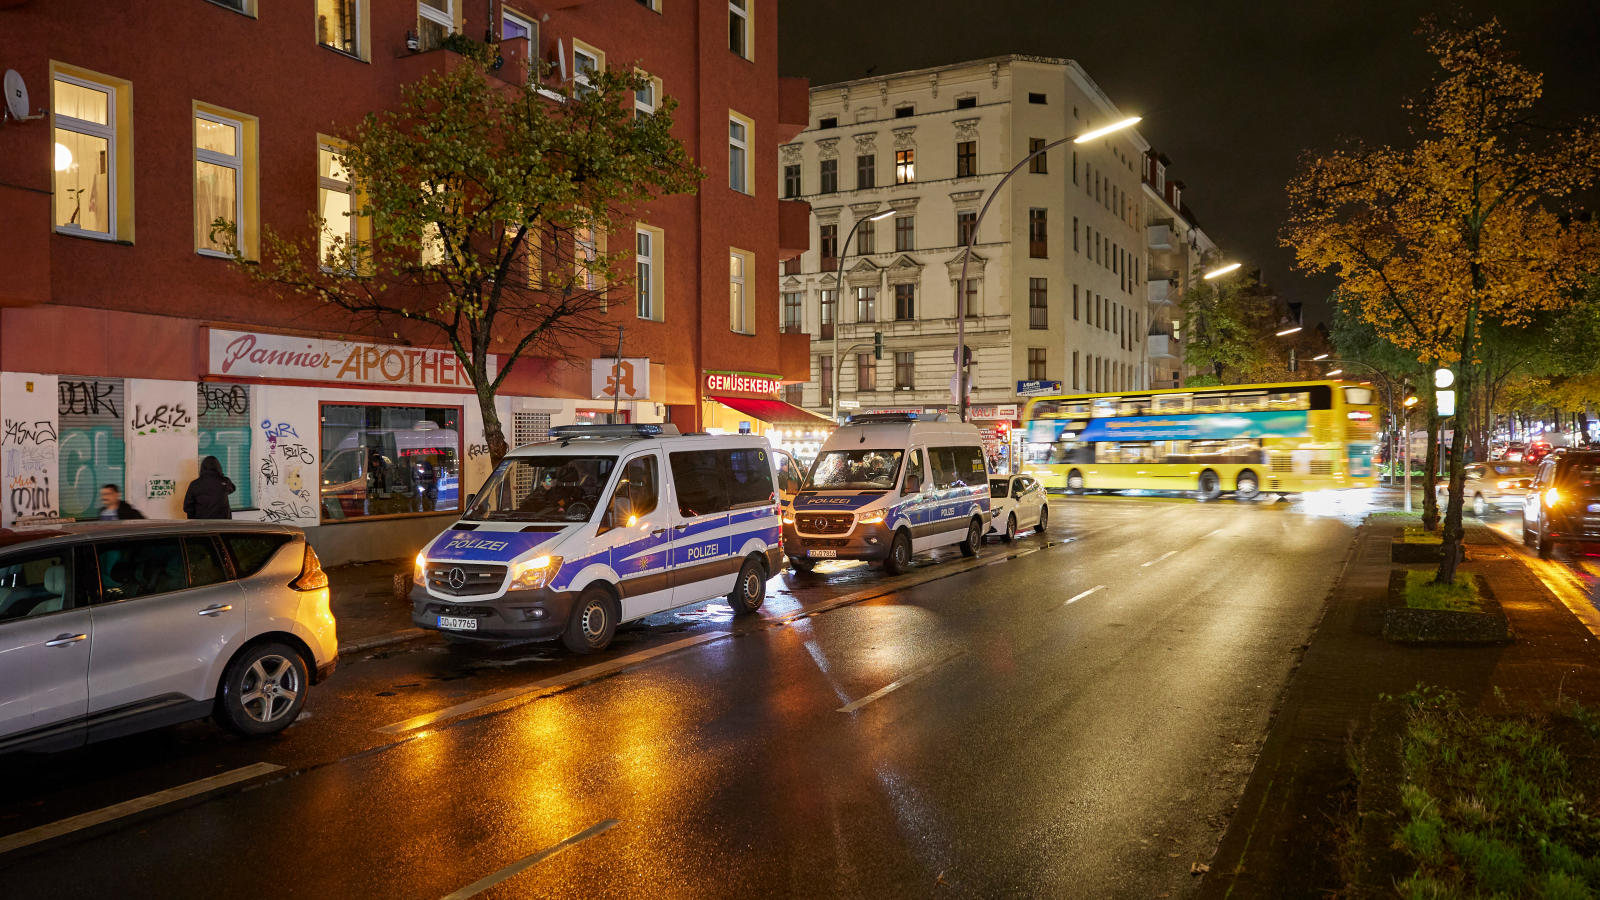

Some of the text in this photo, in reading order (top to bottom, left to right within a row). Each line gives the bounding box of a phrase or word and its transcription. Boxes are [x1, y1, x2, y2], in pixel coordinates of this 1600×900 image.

[222, 334, 475, 386] Pannier-APOTHEK
[708, 373, 780, 394] GEMÜSEKEBAP
[940, 507, 955, 517] POLIZEI
[444, 540, 509, 552] POLIZEI
[688, 543, 719, 560] POLIZEI
[458, 619, 476, 629] 7765
